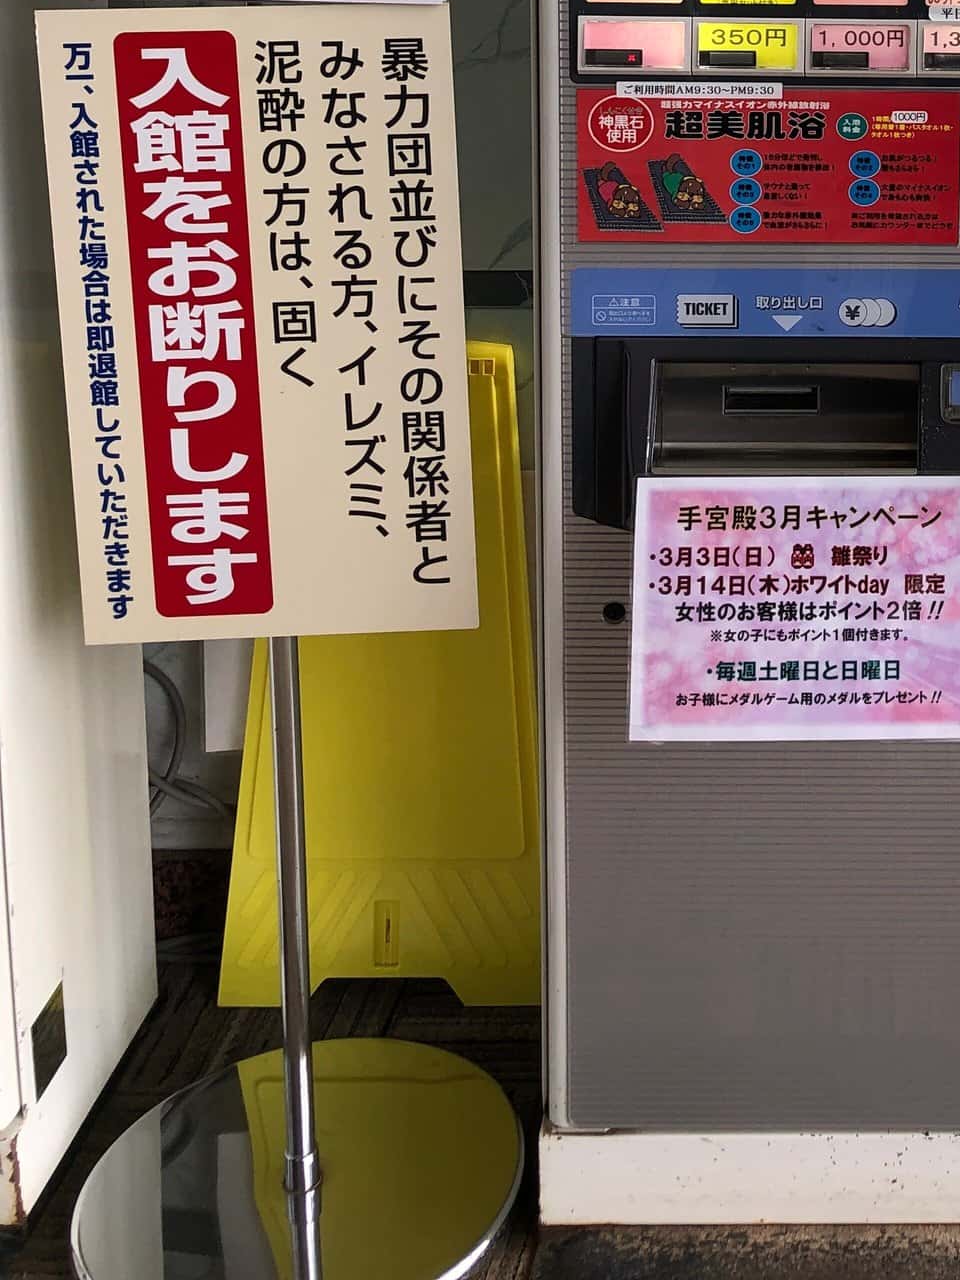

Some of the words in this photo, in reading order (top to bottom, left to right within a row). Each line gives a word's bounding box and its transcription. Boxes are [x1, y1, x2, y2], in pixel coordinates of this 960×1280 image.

[712, 29, 786, 46] 350円
[599, 115, 644, 129] 神黒石
[665, 110, 826, 140] 超美肌浴
[894, 113, 925, 122] 1000円
[607, 130, 637, 143] 使用
[255, 40, 317, 387] 泥酔の方は、固く
[319, 40, 390, 538] みなされる方、イレズミ、
[381, 37, 452, 584] 暴力団並びにその関係者と
[684, 302, 728, 315] TICKET
[756, 296, 823, 309] 取り出し口
[62, 42, 133, 620] 万一、入館された場合は即退館していただきます
[128, 46, 258, 605] 入館をお断りします
[677, 505, 942, 531] 手宮殿3月キャンペーン
[832, 545, 888, 567] 雛祭り
[904, 574, 945, 595] 限定
